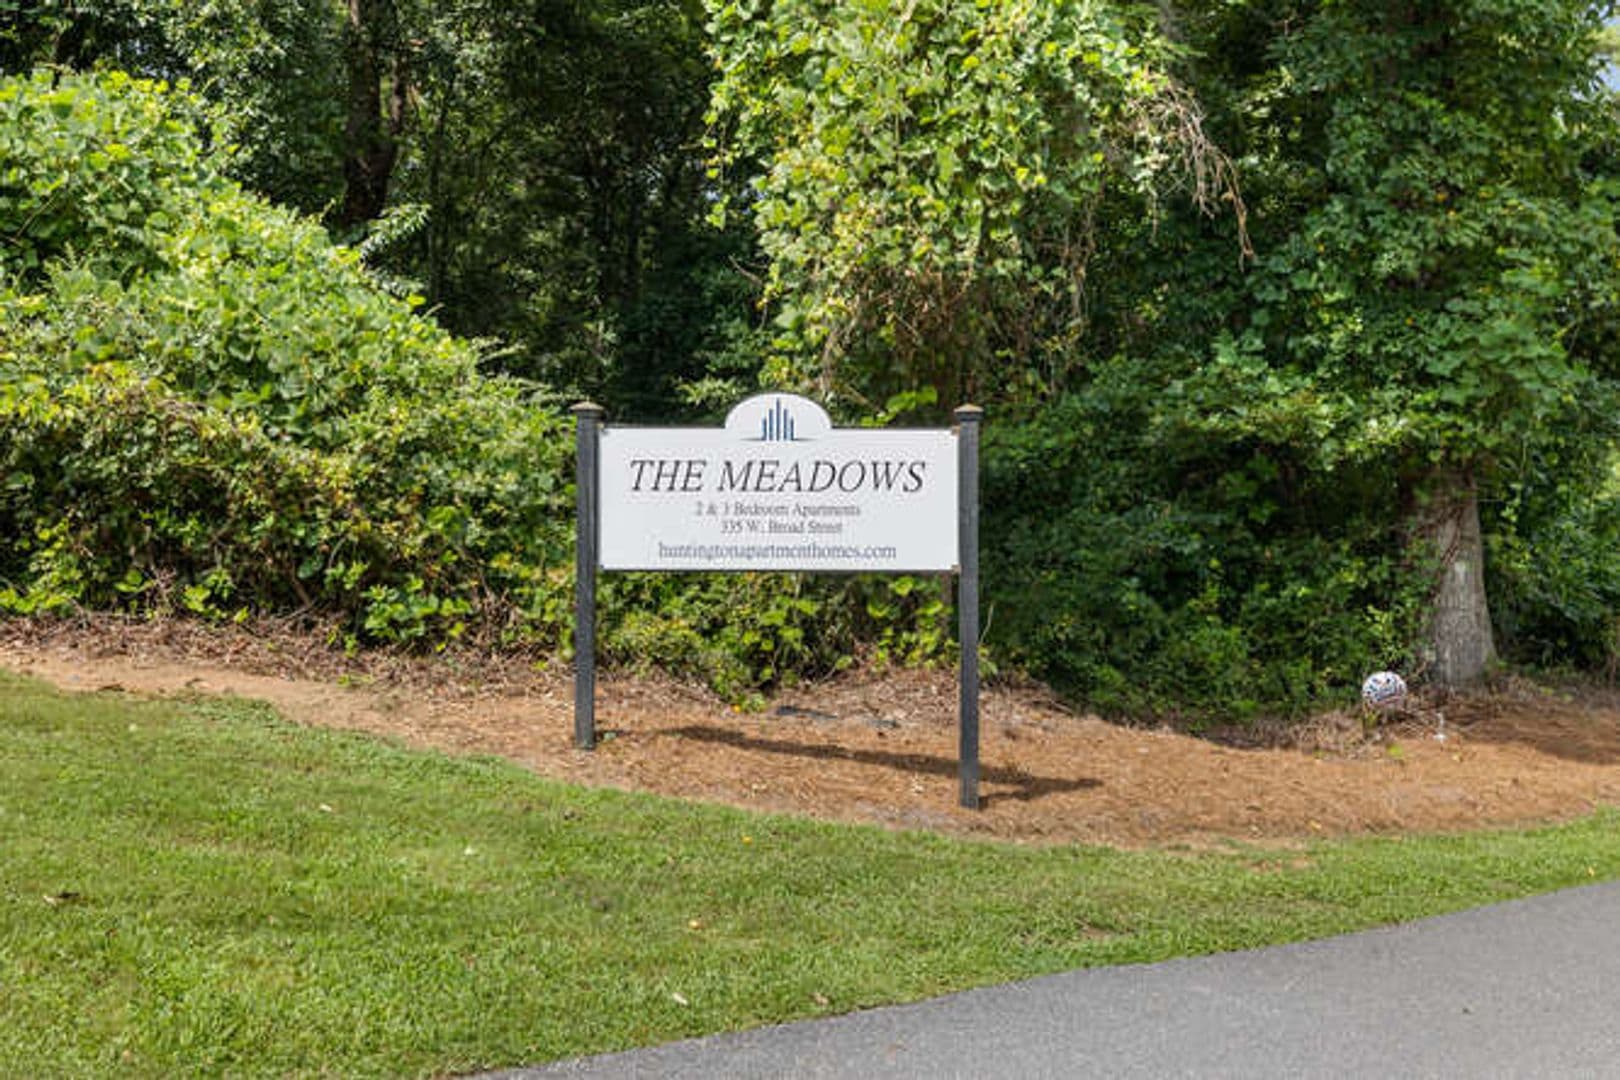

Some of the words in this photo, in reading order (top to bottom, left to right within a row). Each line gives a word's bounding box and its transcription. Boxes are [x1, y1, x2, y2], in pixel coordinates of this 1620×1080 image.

[630, 459, 707, 493] THE
[716, 459, 926, 493] MEADOWS
[706, 503, 718, 516] &
[734, 503, 789, 516] Bedroom
[792, 503, 861, 519] Apartments
[746, 521, 765, 534] W.
[768, 521, 804, 534] Broad
[807, 521, 843, 534] Street
[658, 541, 897, 561] huntingtonapartmenthomes.com
